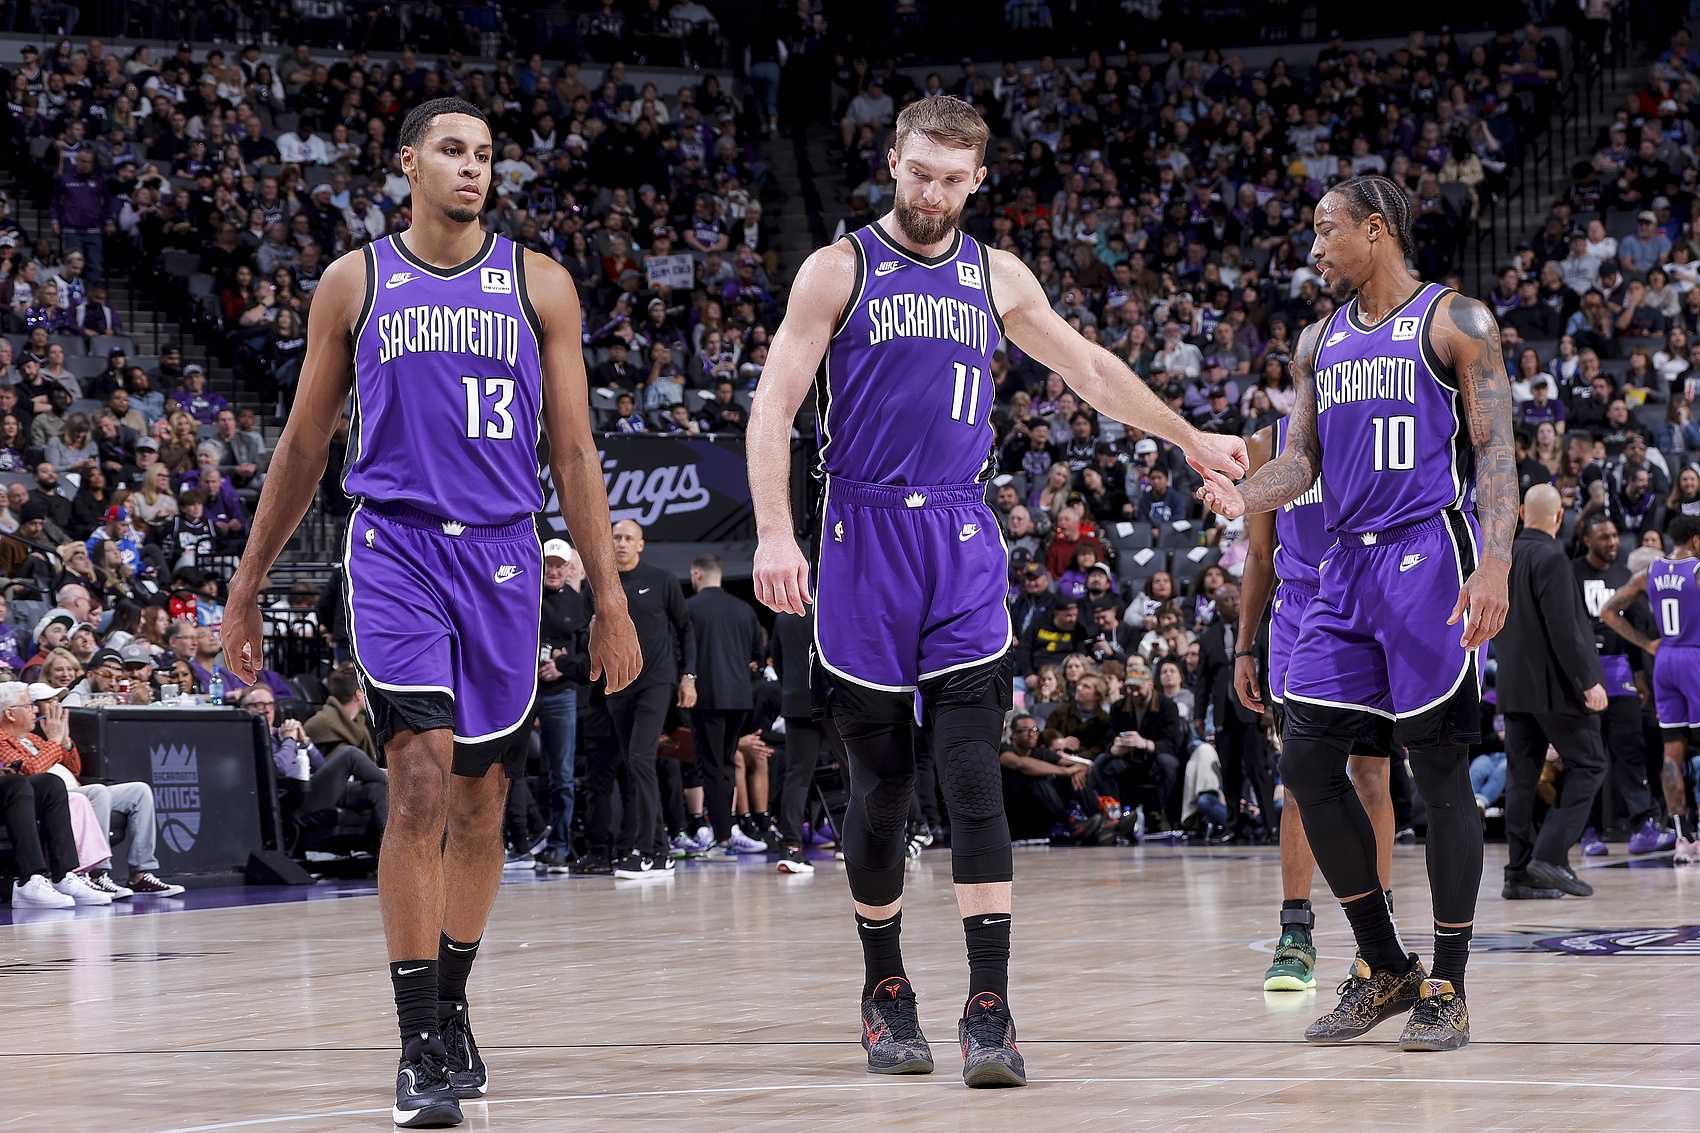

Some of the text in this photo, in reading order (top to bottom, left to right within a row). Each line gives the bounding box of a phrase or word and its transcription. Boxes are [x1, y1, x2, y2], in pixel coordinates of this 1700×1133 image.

[390, 272, 412, 283] NIKE
[488, 271, 505, 285] R
[879, 261, 899, 271] NIKE
[377, 305, 519, 368] SACRAMENTO
[868, 293, 988, 359] SACRAMENTO
[950, 360, 982, 427] 11
[1316, 356, 1416, 416] SACRAMENTO
[461, 375, 516, 441] 13
[1372, 414, 1416, 472] 10
[541, 449, 711, 533] ings
[963, 524, 977, 535] NIKE
[497, 564, 517, 577] NIKE
[1402, 553, 1420, 566] NIKE
[1653, 573, 1686, 592] MONK
[1660, 597, 1681, 637] 0
[153, 786, 201, 810] KINGS
